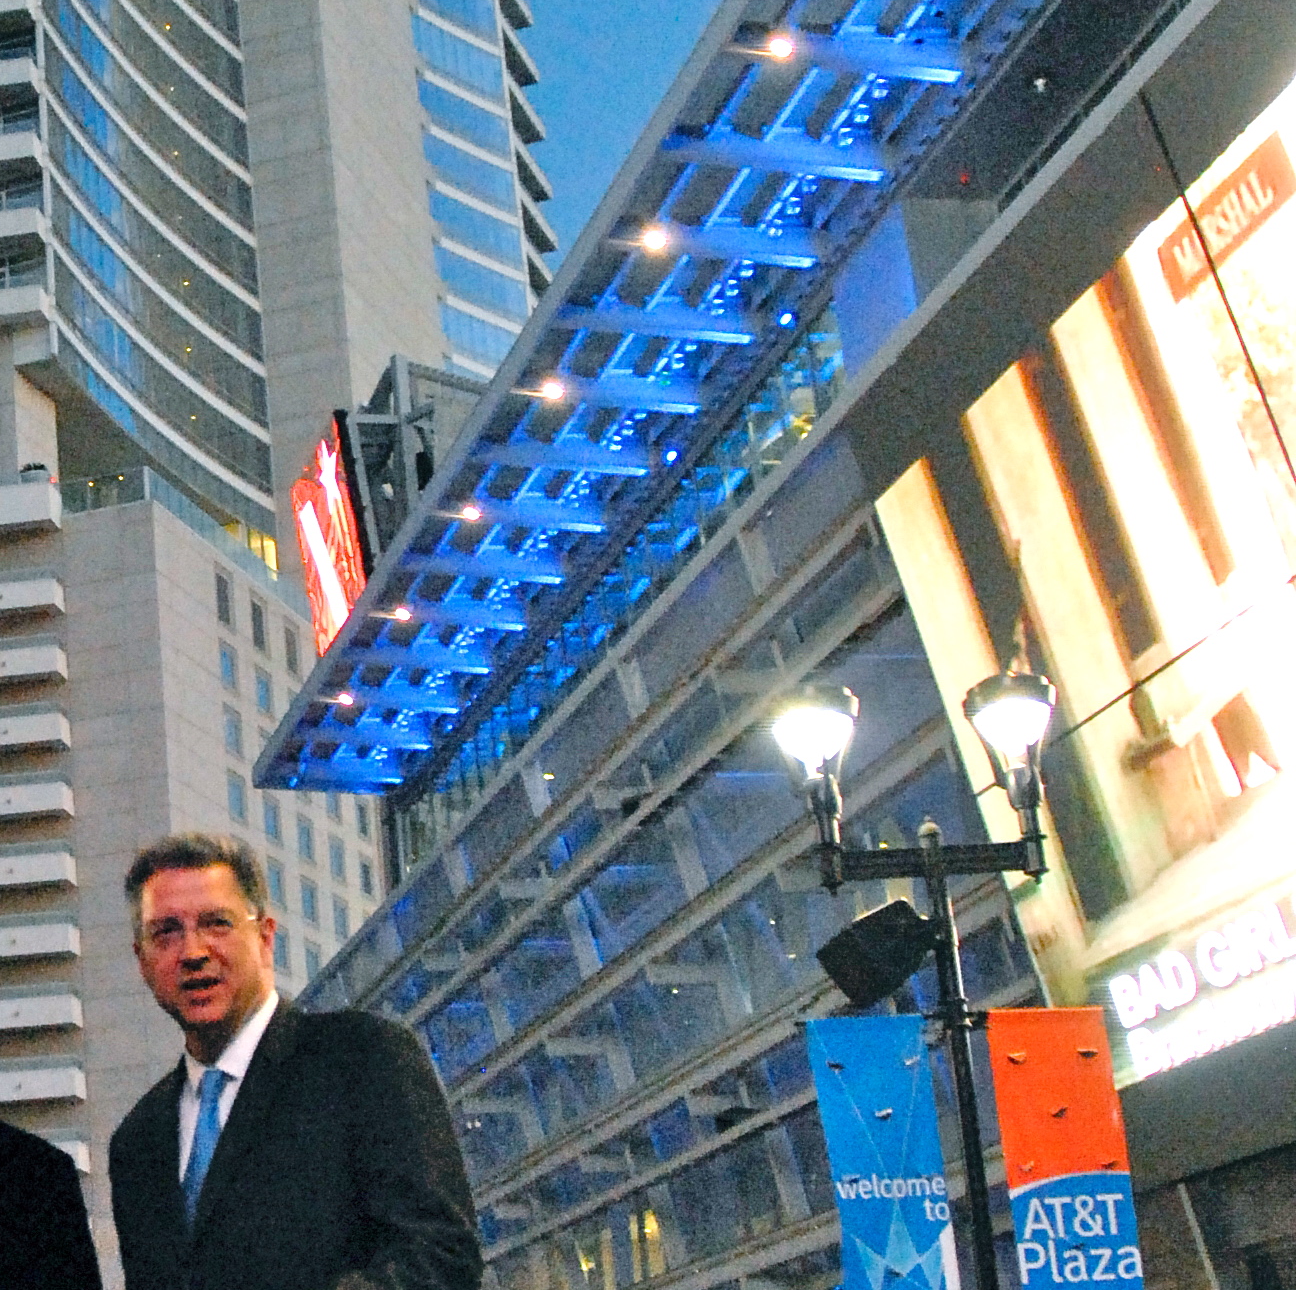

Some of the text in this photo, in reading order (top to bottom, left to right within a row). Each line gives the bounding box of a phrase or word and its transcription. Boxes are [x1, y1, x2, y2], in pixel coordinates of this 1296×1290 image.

[1109, 949, 1199, 1029] BAD
[836, 1173, 946, 1199] welcome
[923, 1198, 950, 1221] to
[1024, 1193, 1124, 1239] AT&T
[1016, 1239, 1144, 1285] Plaza
